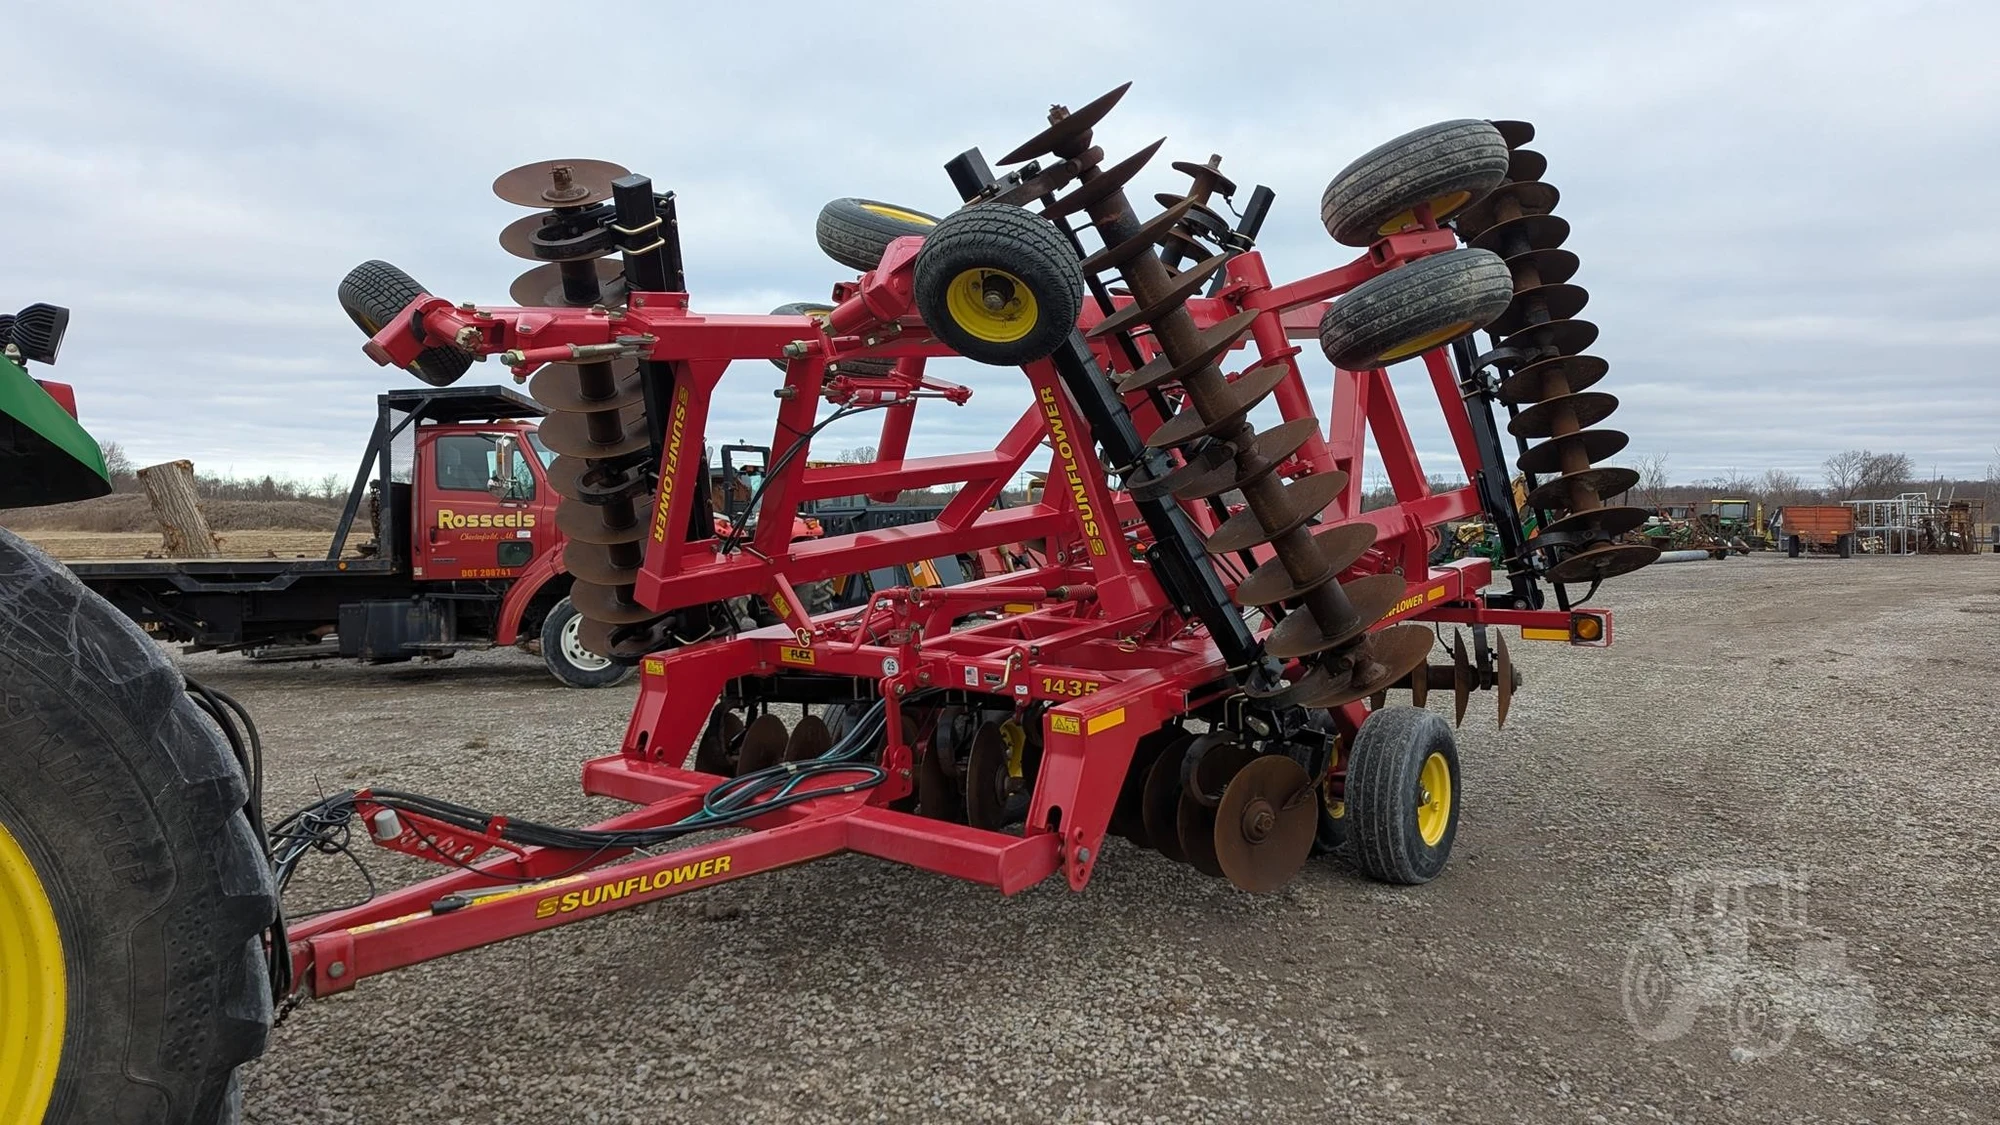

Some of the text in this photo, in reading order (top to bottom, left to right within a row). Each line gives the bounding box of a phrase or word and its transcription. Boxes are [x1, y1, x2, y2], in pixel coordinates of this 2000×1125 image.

[1040, 387, 1100, 539] SUNFLOWER
[654, 403, 686, 543] SUNFLOWER
[438, 509, 535, 529] Rosseels
[461, 569, 477, 577] DOT
[791, 649, 811, 660] FLEX
[886, 661, 896, 671] 25
[1042, 678, 1099, 697] 1435
[560, 855, 732, 913] SUNFLOWER
